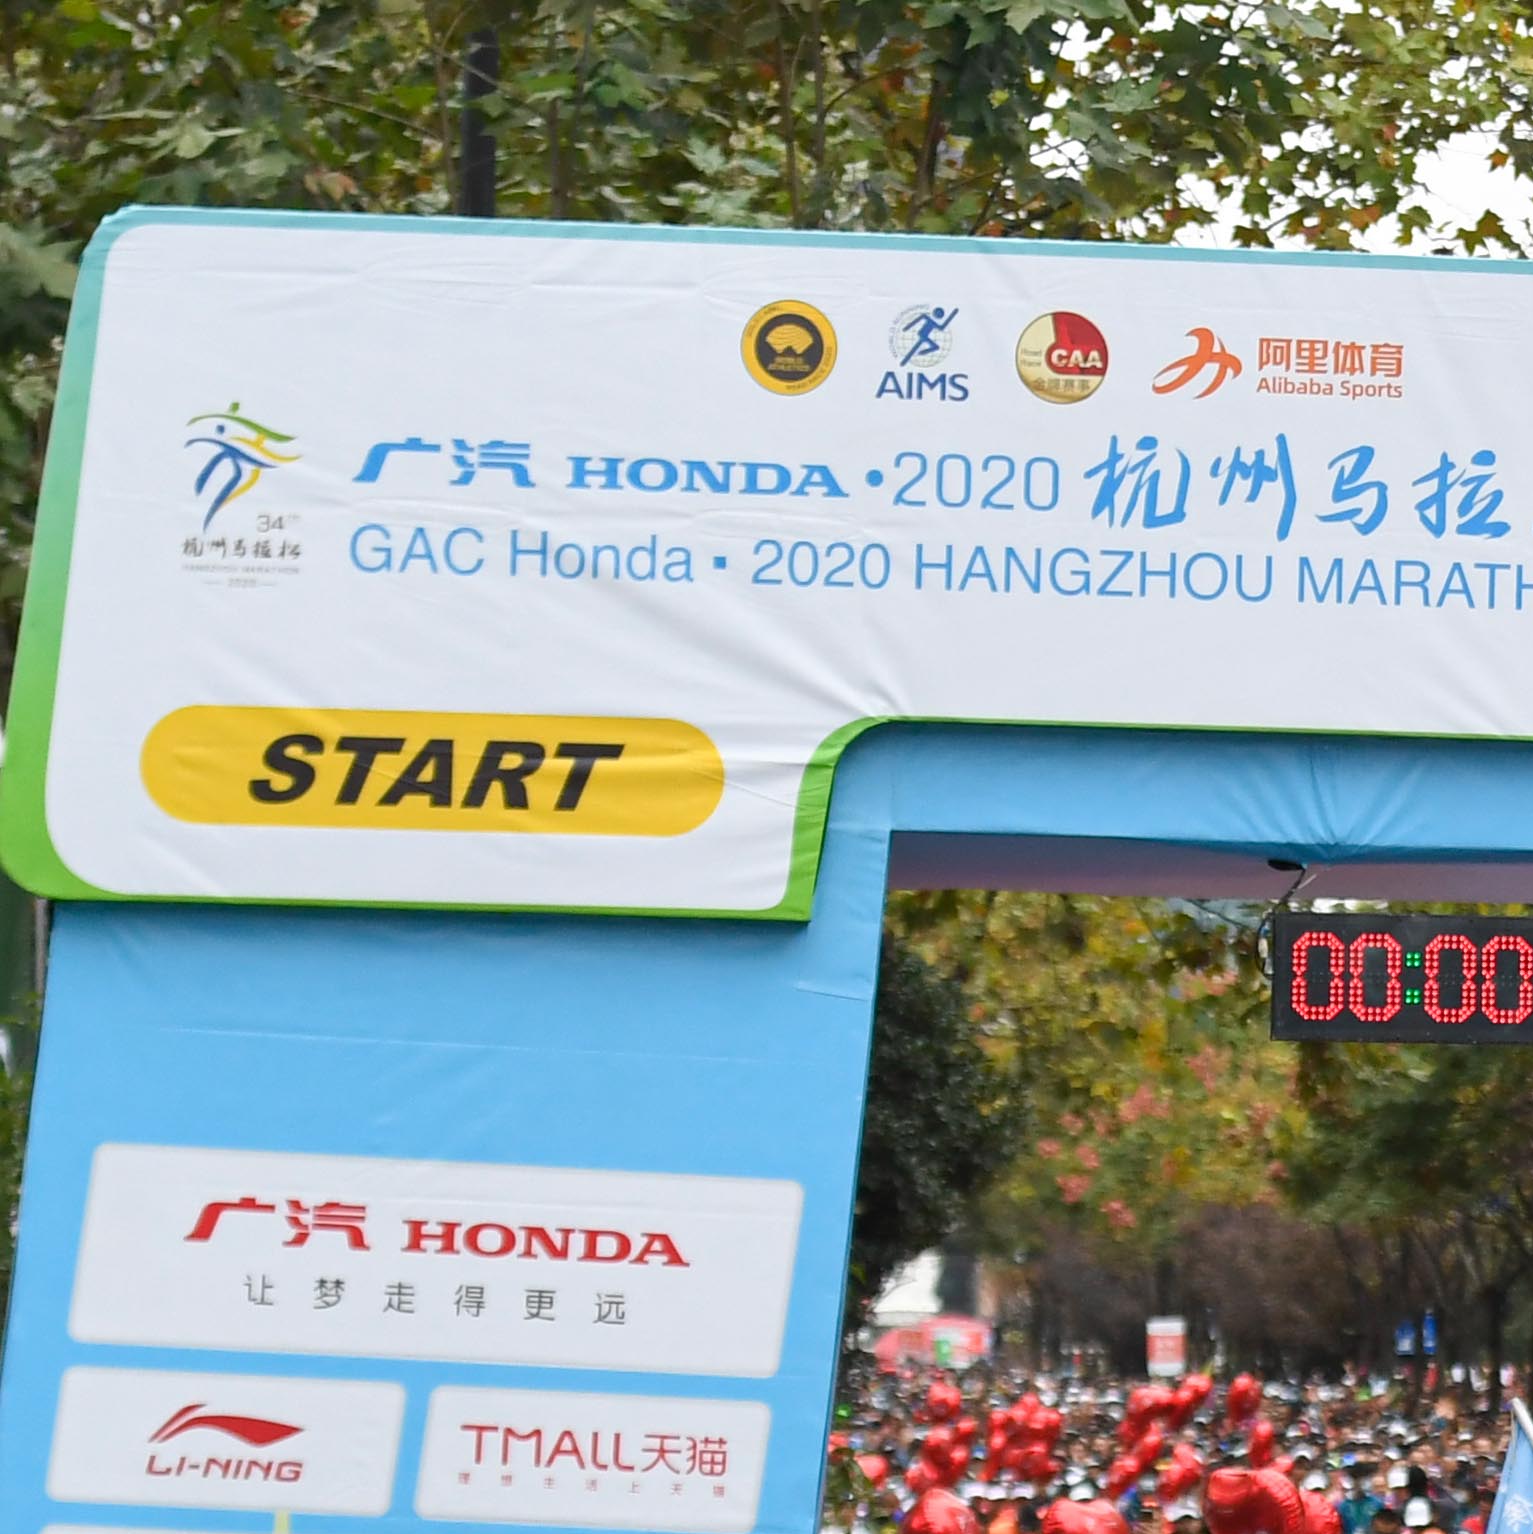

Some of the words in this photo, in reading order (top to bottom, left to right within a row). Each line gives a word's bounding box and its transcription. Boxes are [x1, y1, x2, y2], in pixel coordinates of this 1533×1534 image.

[1051, 348, 1104, 369] CAA
[1257, 337, 1404, 378] 阿里体育
[876, 371, 969, 401] AIMS
[1256, 379, 1334, 397] Alibaba
[1340, 381, 1403, 400] Sports
[352, 436, 536, 489] 广汽
[566, 455, 850, 499] HONDA
[892, 449, 1062, 513] 2020
[348, 523, 485, 577] GAC
[509, 529, 695, 584] Honda
[751, 537, 893, 591] 2020
[914, 543, 1275, 604] HANGZHOU
[249, 732, 626, 812] START
[186, 1196, 371, 1251] 广汽
[403, 1219, 690, 1268] HONDA
[242, 1273, 627, 1326] 让梦走得更远
[146, 1454, 304, 1484] LI-NING
